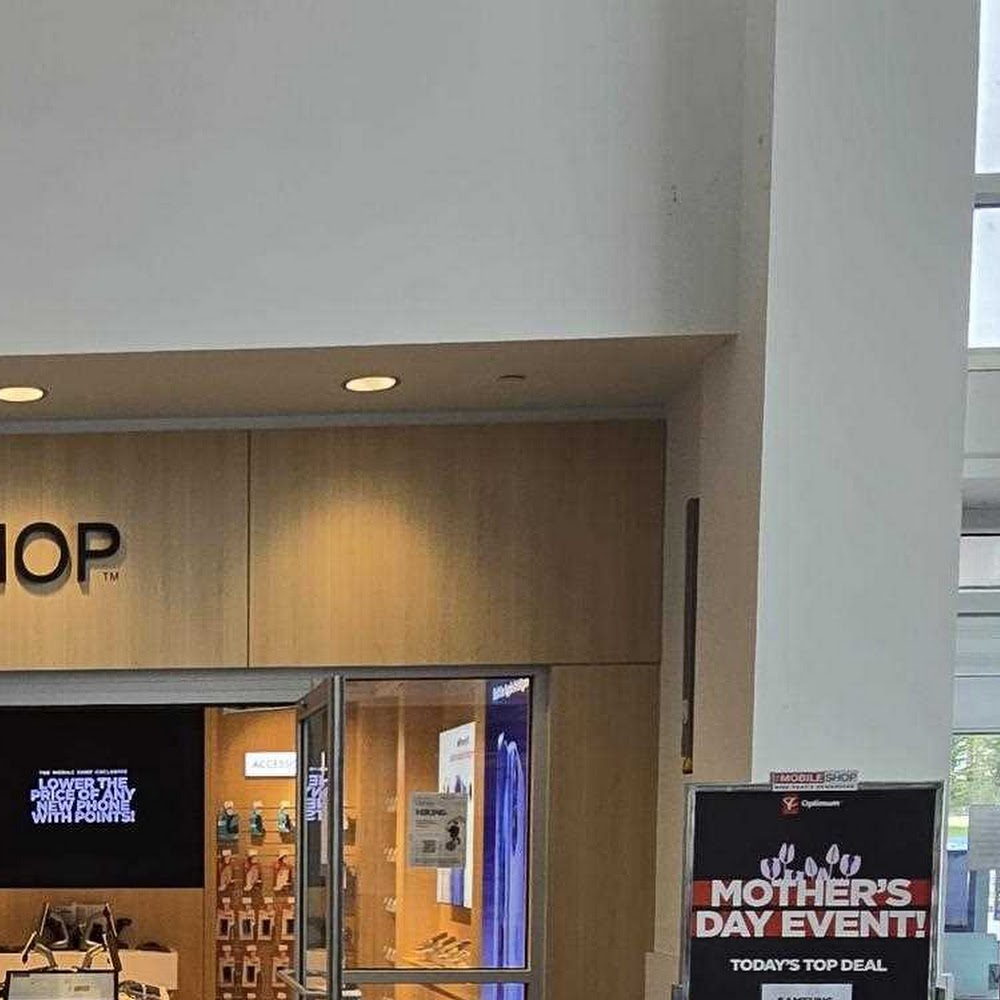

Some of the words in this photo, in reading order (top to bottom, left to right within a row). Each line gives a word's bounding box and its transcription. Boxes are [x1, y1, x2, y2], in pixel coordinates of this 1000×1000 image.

[39, 778, 95, 790] LOWER
[96, 777, 128, 790] THE
[30, 788, 76, 801] PRICE
[77, 788, 100, 801] OF
[101, 787, 136, 801] ANY
[36, 800, 74, 812] NEW
[76, 800, 130, 812] PHONE
[31, 811, 72, 823] WITH
[74, 810, 135, 823] POINTS!
[711, 878, 912, 907] MOTHER'S
[696, 910, 773, 937] DAY
[782, 910, 926, 938] EVENT!
[730, 959, 800, 972] TODAY'S
[803, 959, 838, 972] TOP
[840, 959, 888, 971] DEAL
